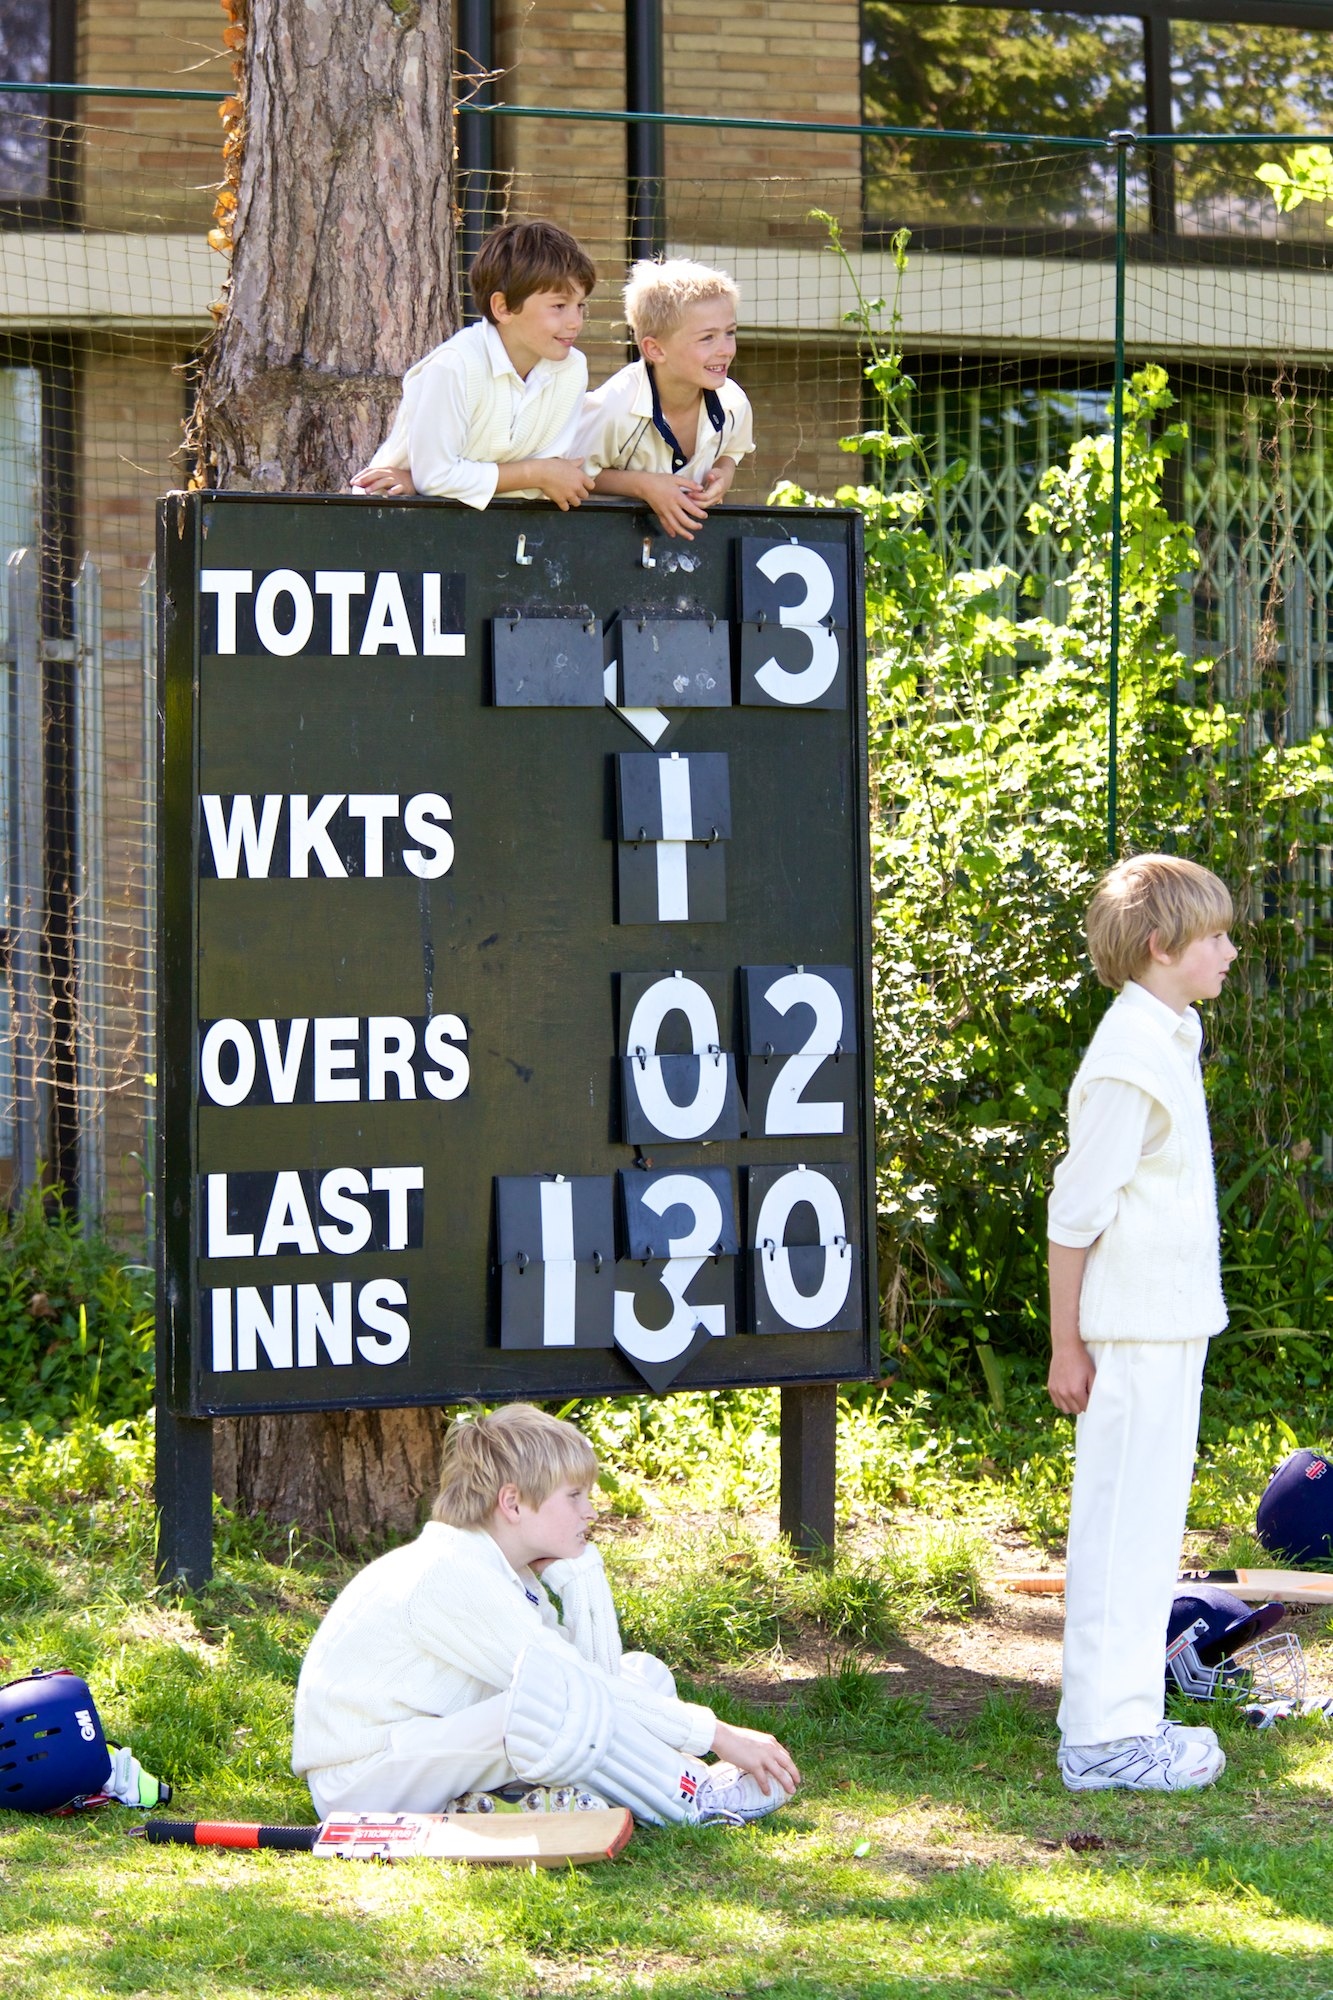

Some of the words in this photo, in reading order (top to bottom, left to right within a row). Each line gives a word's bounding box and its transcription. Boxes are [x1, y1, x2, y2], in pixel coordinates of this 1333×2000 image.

[201, 569, 466, 657] TOTAL
[754, 545, 840, 705] 3
[201, 792, 455, 880] WKTS
[201, 1013, 470, 1107] OVERS
[208, 1166, 424, 1258] LAST
[211, 1278, 411, 1372] INNS
[75, 1710, 96, 1741] GM
